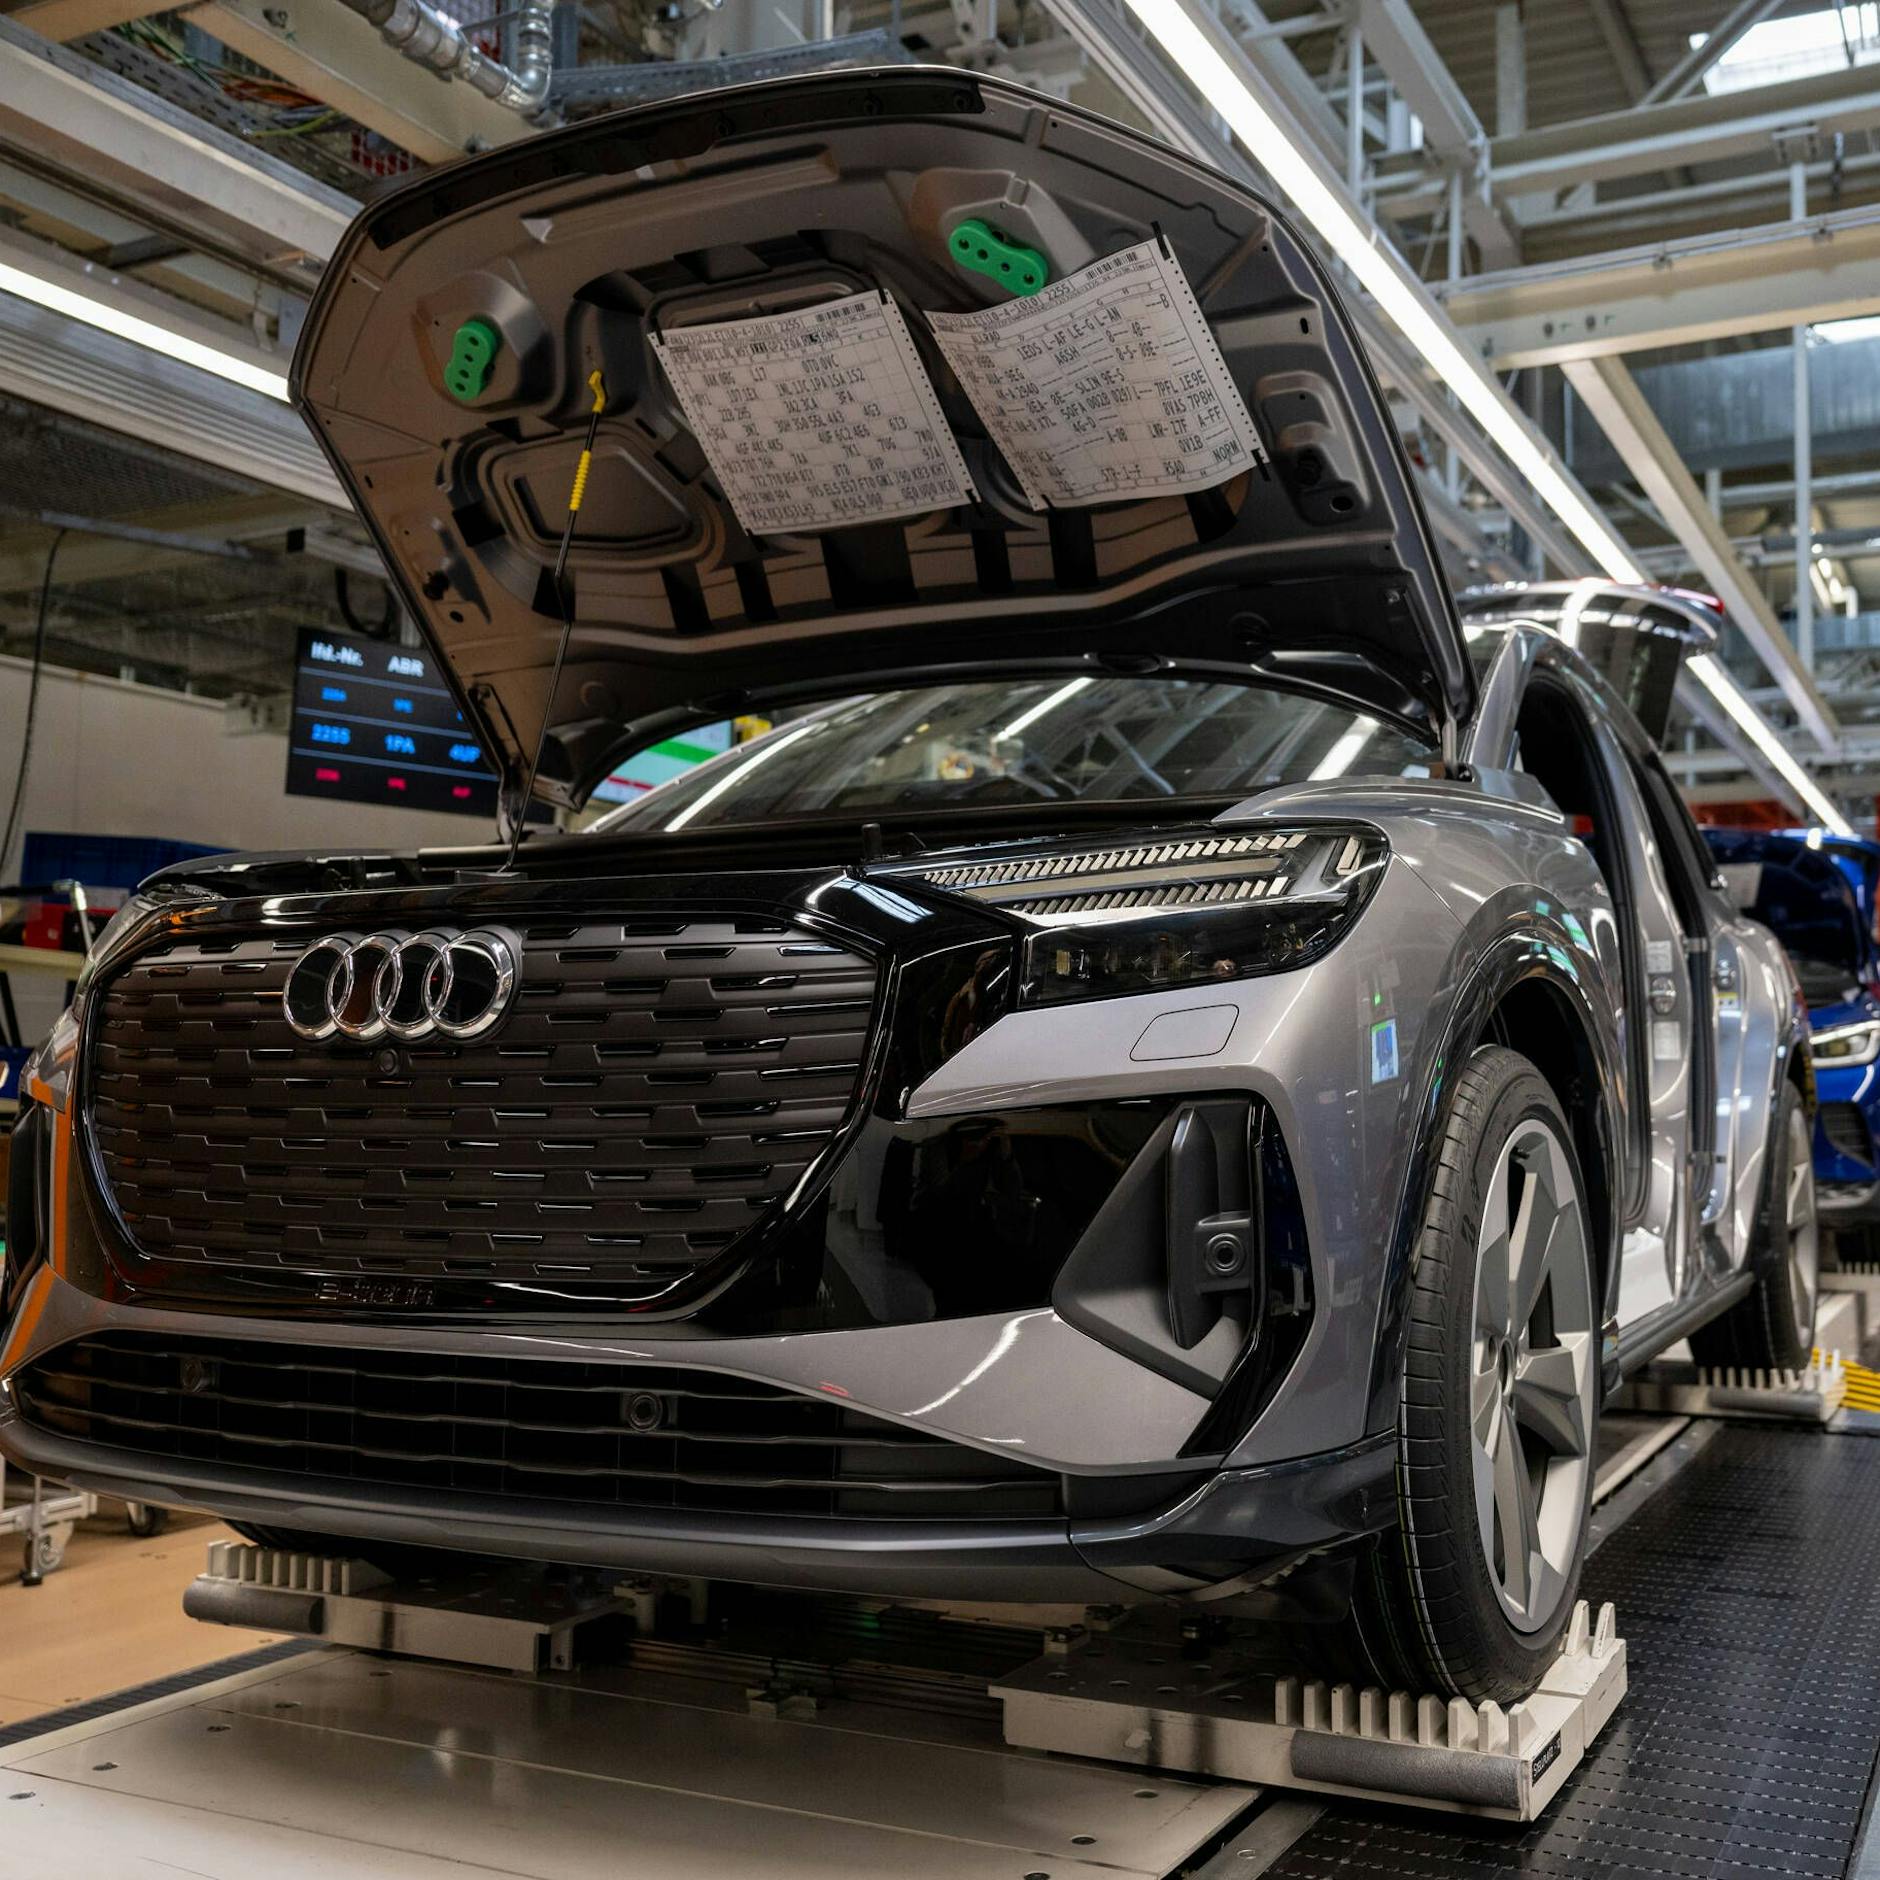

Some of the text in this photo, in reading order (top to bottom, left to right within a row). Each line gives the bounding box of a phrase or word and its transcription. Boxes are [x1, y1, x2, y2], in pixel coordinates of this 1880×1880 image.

[1044, 285, 1071, 299] 2255
[778, 320, 800, 331] 2255
[1041, 331, 1069, 349] L-AF
[1065, 317, 1096, 338] LE-G
[1094, 306, 1121, 325] L-AN
[1053, 347, 1081, 365] A6SH
[845, 368, 865, 381] 1S2
[1177, 369, 1207, 389] 1E9E
[1194, 406, 1224, 426] A-FF
[1210, 441, 1241, 460] NORM
[387, 656, 424, 678] ABR
